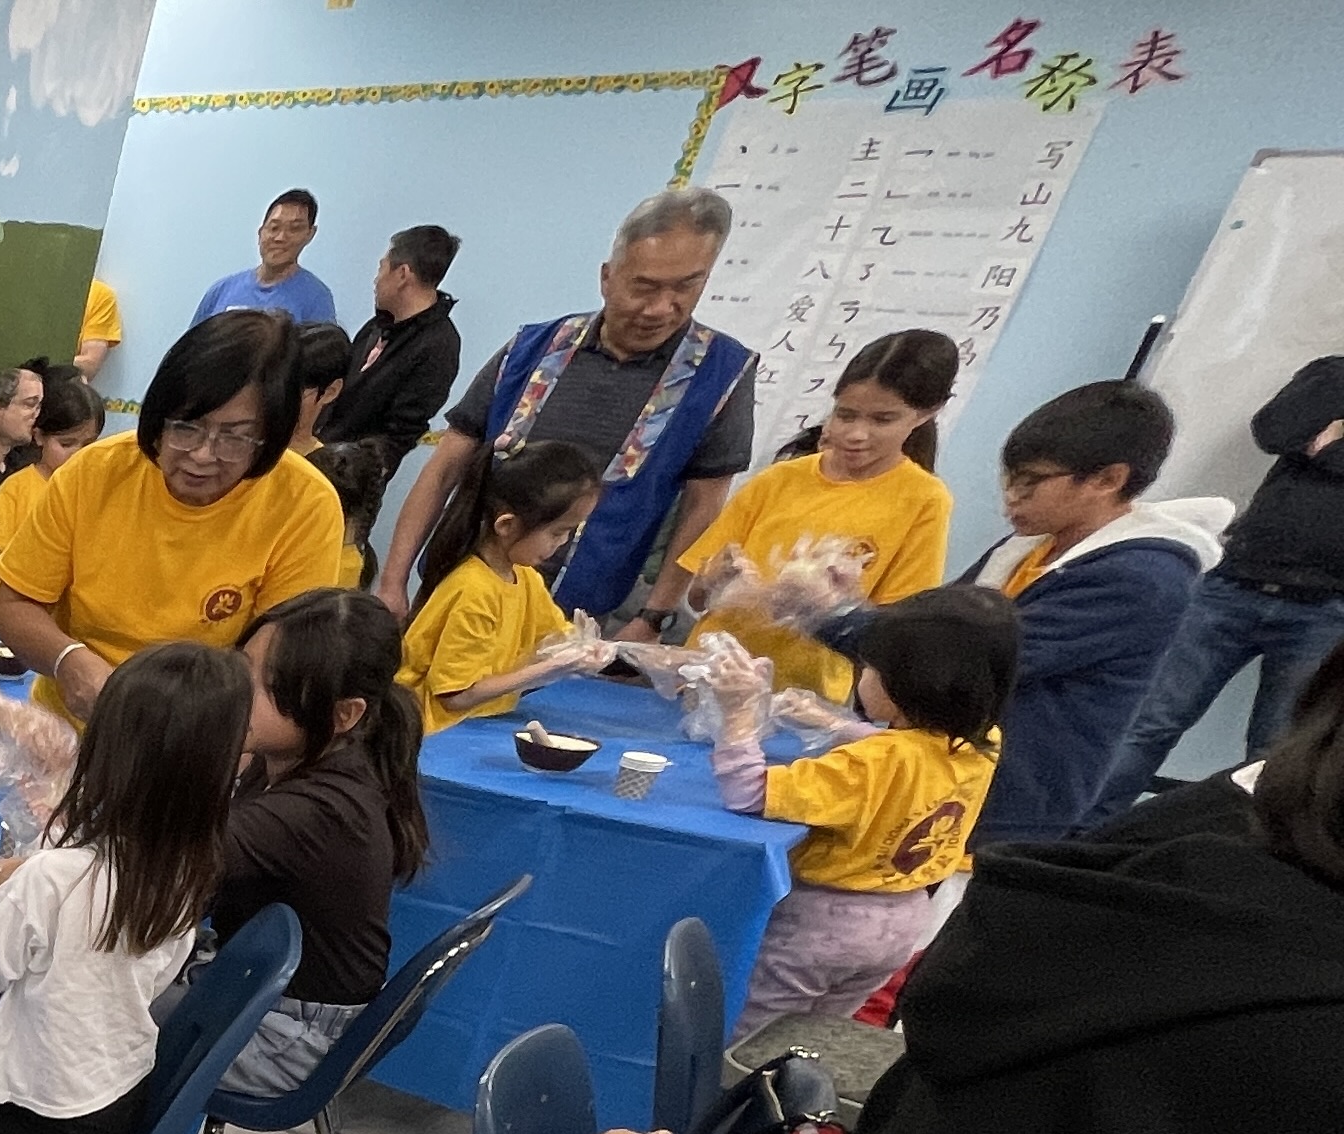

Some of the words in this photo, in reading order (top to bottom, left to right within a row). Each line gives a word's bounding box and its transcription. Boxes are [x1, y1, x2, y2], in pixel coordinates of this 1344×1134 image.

[851, 137, 882, 161] 主
[1036, 140, 1073, 169] 写
[1020, 182, 1052, 206] 山
[824, 215, 851, 240] 十
[1000, 216, 1034, 243] 九
[803, 260, 831, 280] 八
[981, 264, 1016, 288] 阳
[786, 294, 816, 323] 爱
[969, 306, 1002, 331] 乃
[772, 330, 795, 352] 人
